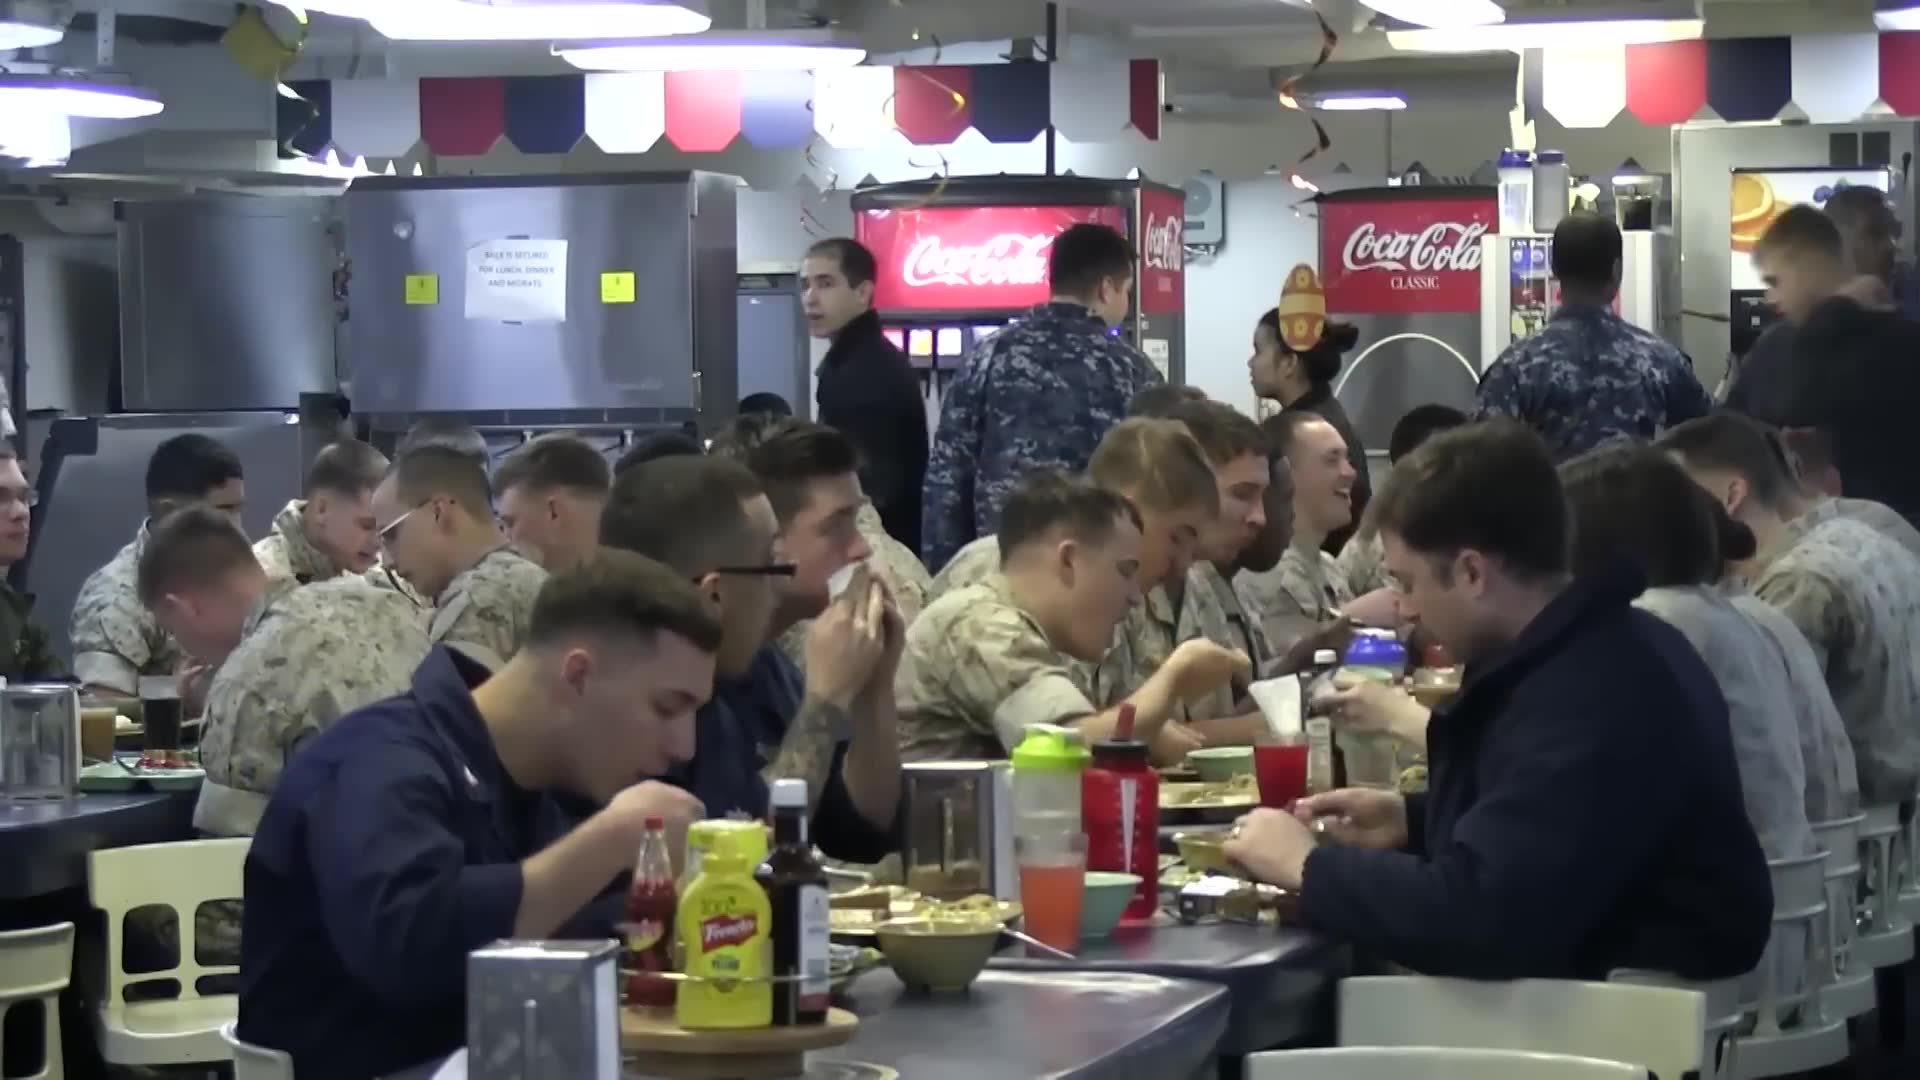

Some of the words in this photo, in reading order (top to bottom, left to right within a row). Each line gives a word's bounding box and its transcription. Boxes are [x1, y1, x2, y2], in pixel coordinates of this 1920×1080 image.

[903, 233, 1055, 287] Coca-Cola
[1343, 221, 1489, 271] Coca-Cola
[1391, 276, 1440, 290] CLASSIC
